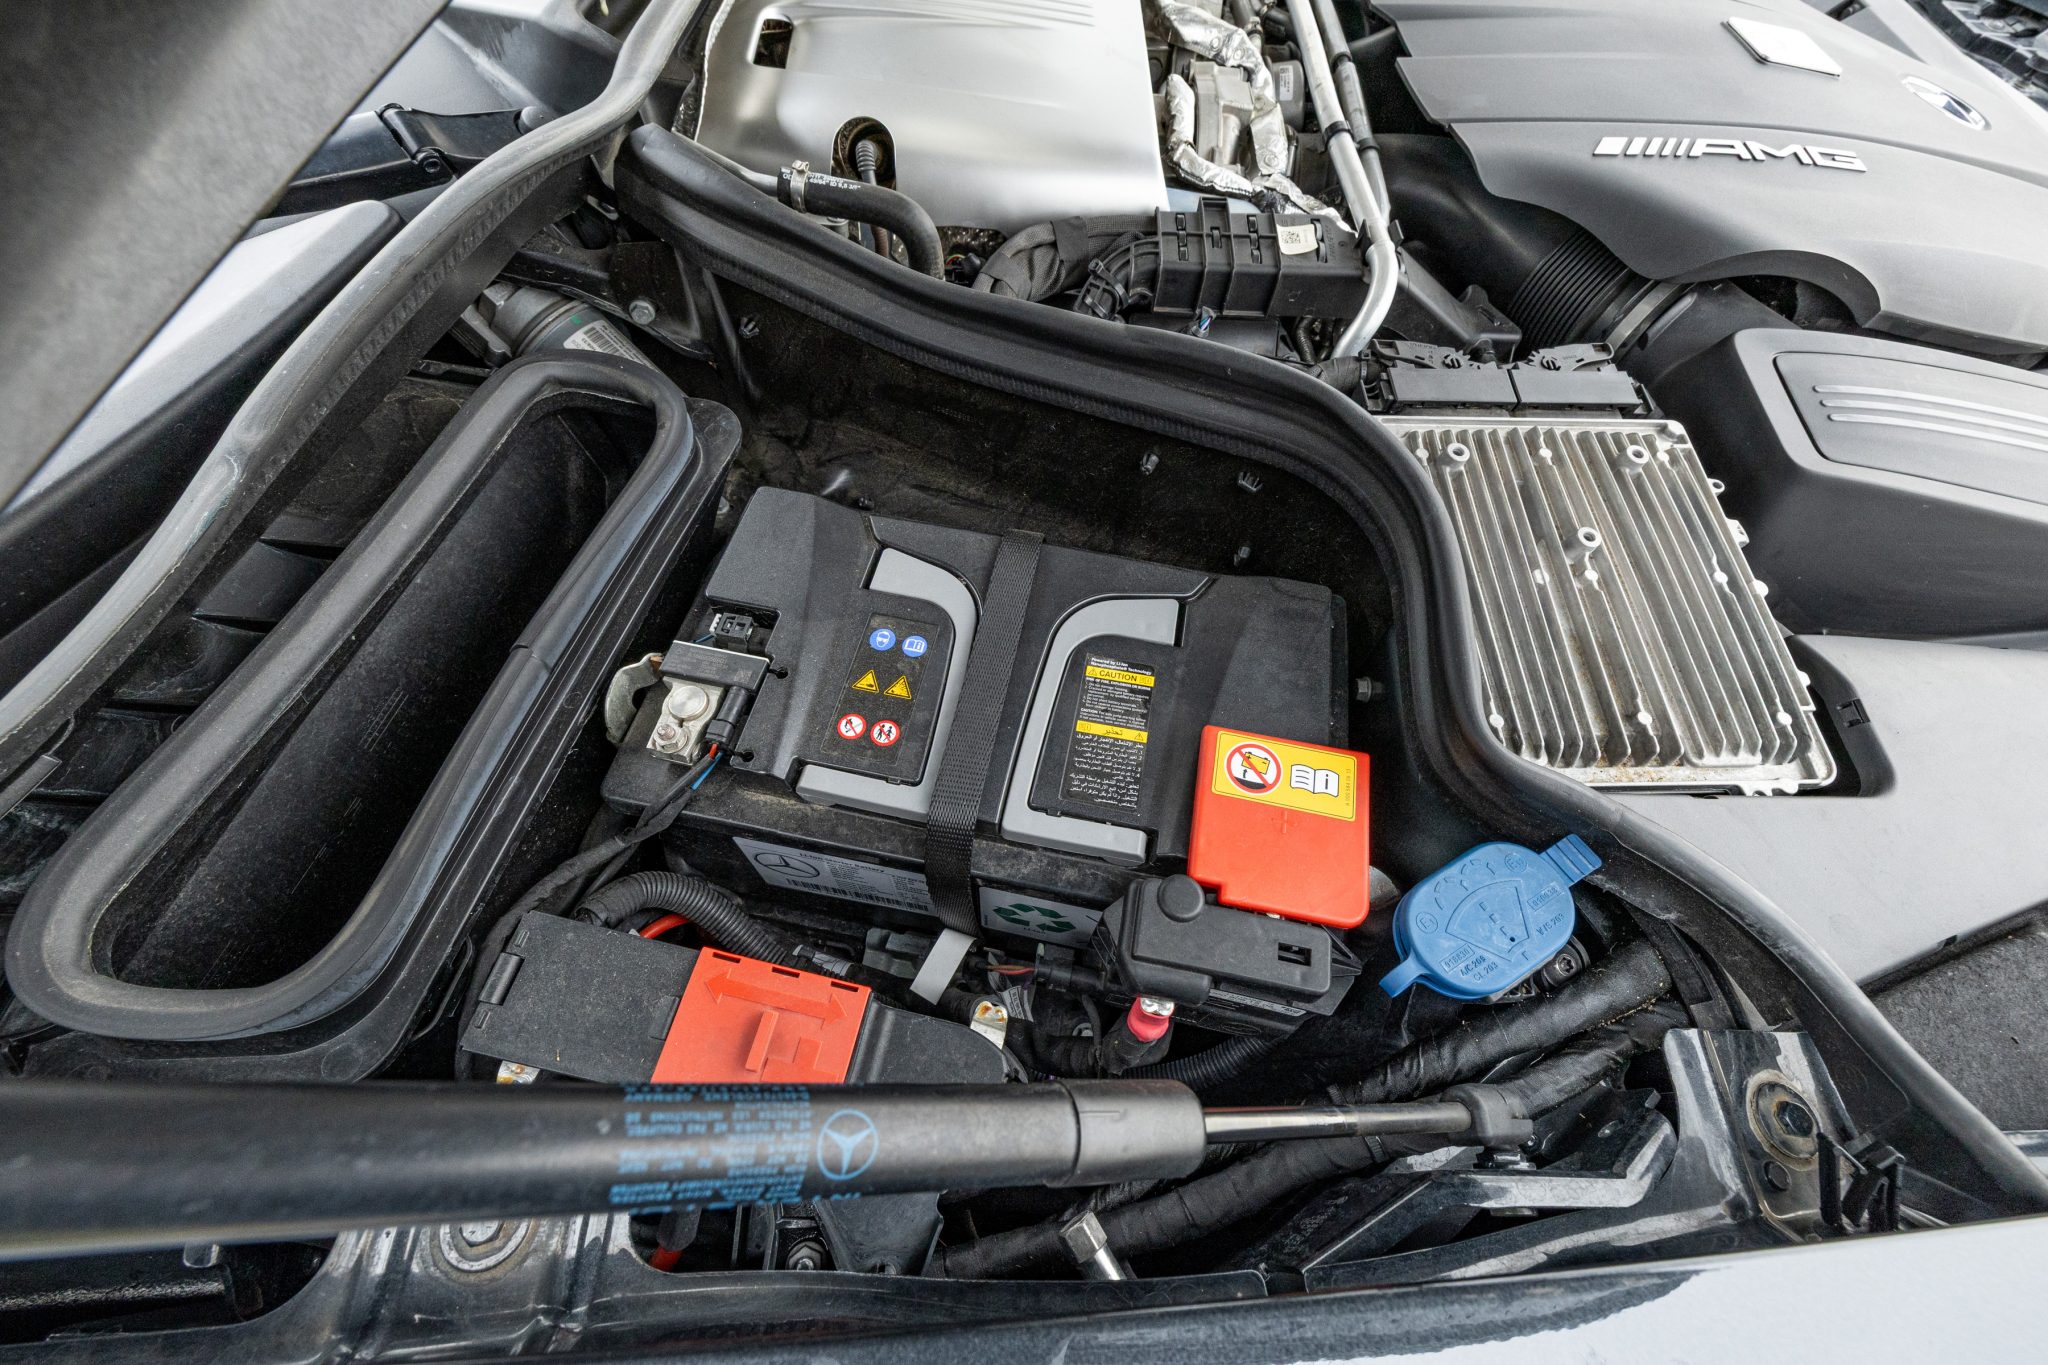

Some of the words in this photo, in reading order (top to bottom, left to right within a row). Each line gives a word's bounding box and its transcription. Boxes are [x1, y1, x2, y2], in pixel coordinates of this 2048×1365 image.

[1688, 137, 1867, 172] AMG
[1099, 670, 1137, 682] CAUTION
[1483, 961, 1498, 974] 203
